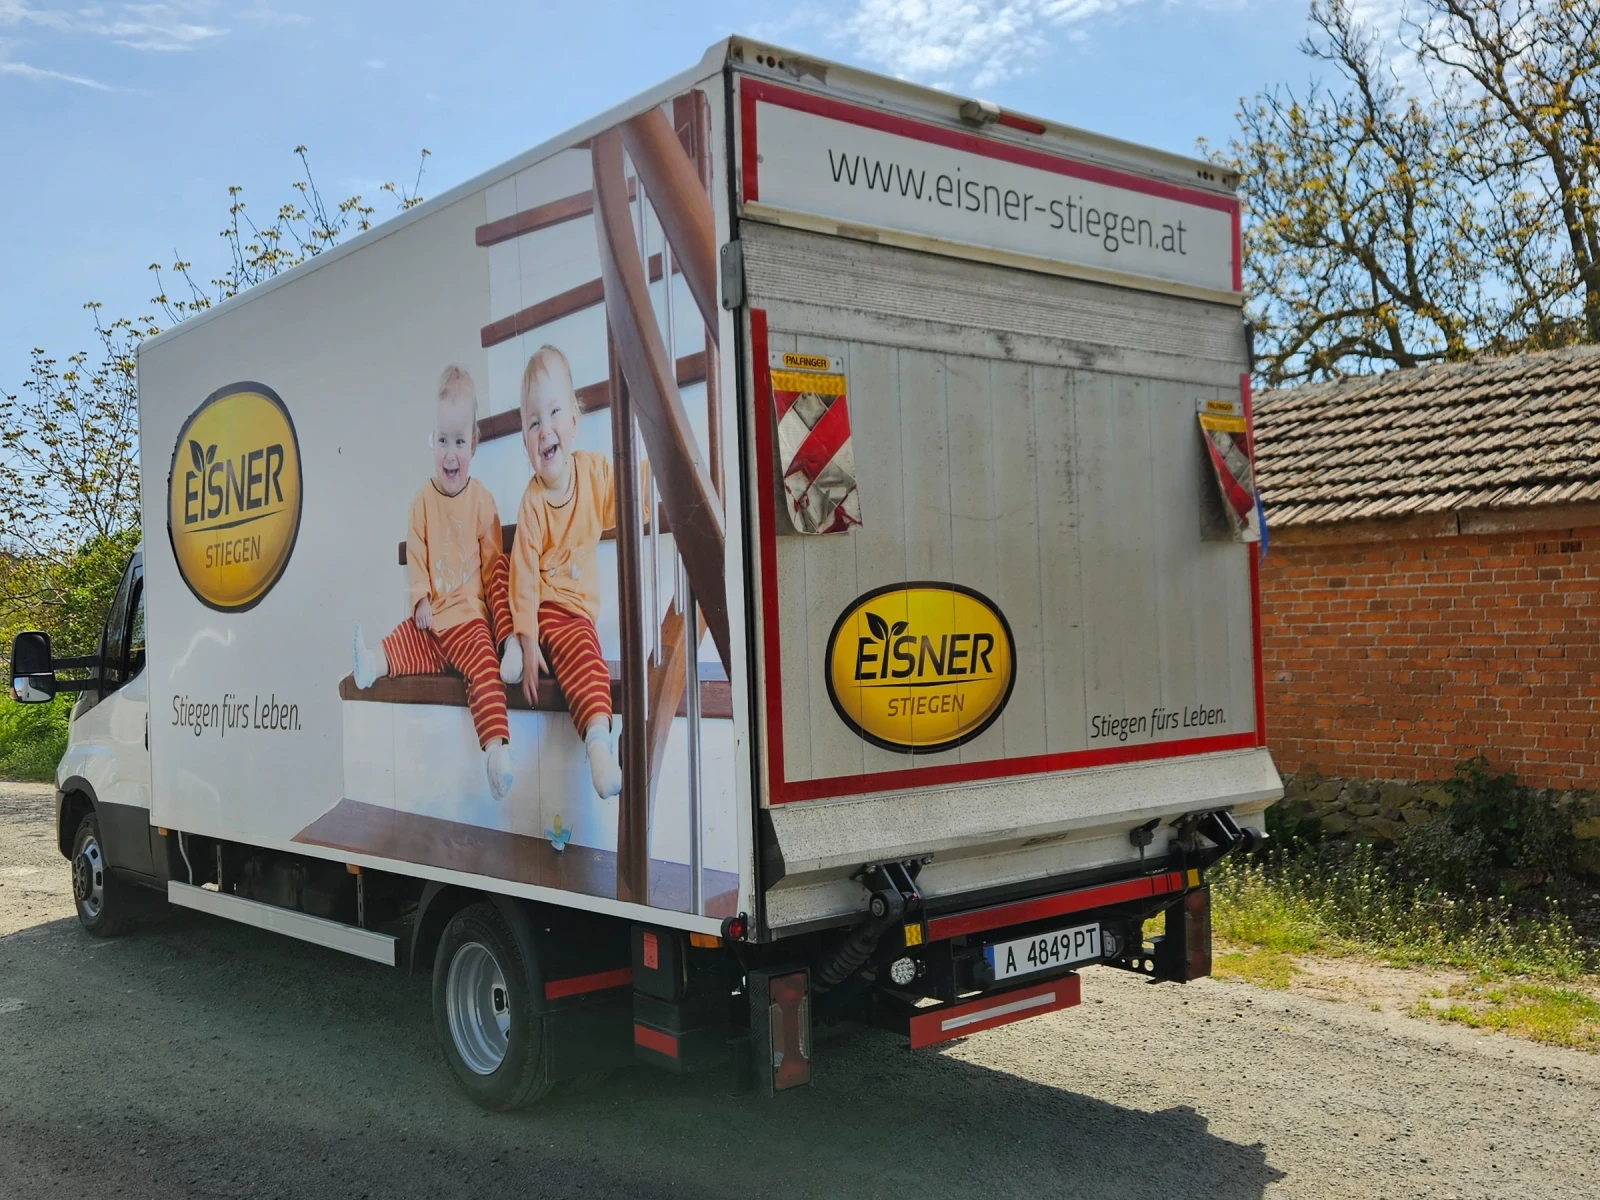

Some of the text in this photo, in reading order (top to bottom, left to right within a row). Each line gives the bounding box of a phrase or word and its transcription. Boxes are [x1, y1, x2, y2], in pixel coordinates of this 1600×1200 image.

[828, 148, 1187, 255] www.eisner-stiegen.at
[785, 355, 827, 368] PALFINGER
[184, 443, 285, 525] EISNER
[205, 535, 261, 569] STIEGEN
[854, 632, 995, 681] EISNER
[171, 693, 302, 738] Stiegen fürs Leben.
[887, 693, 965, 717] STIEGEN
[1090, 703, 1227, 742] Stiegen fürs Leben.
